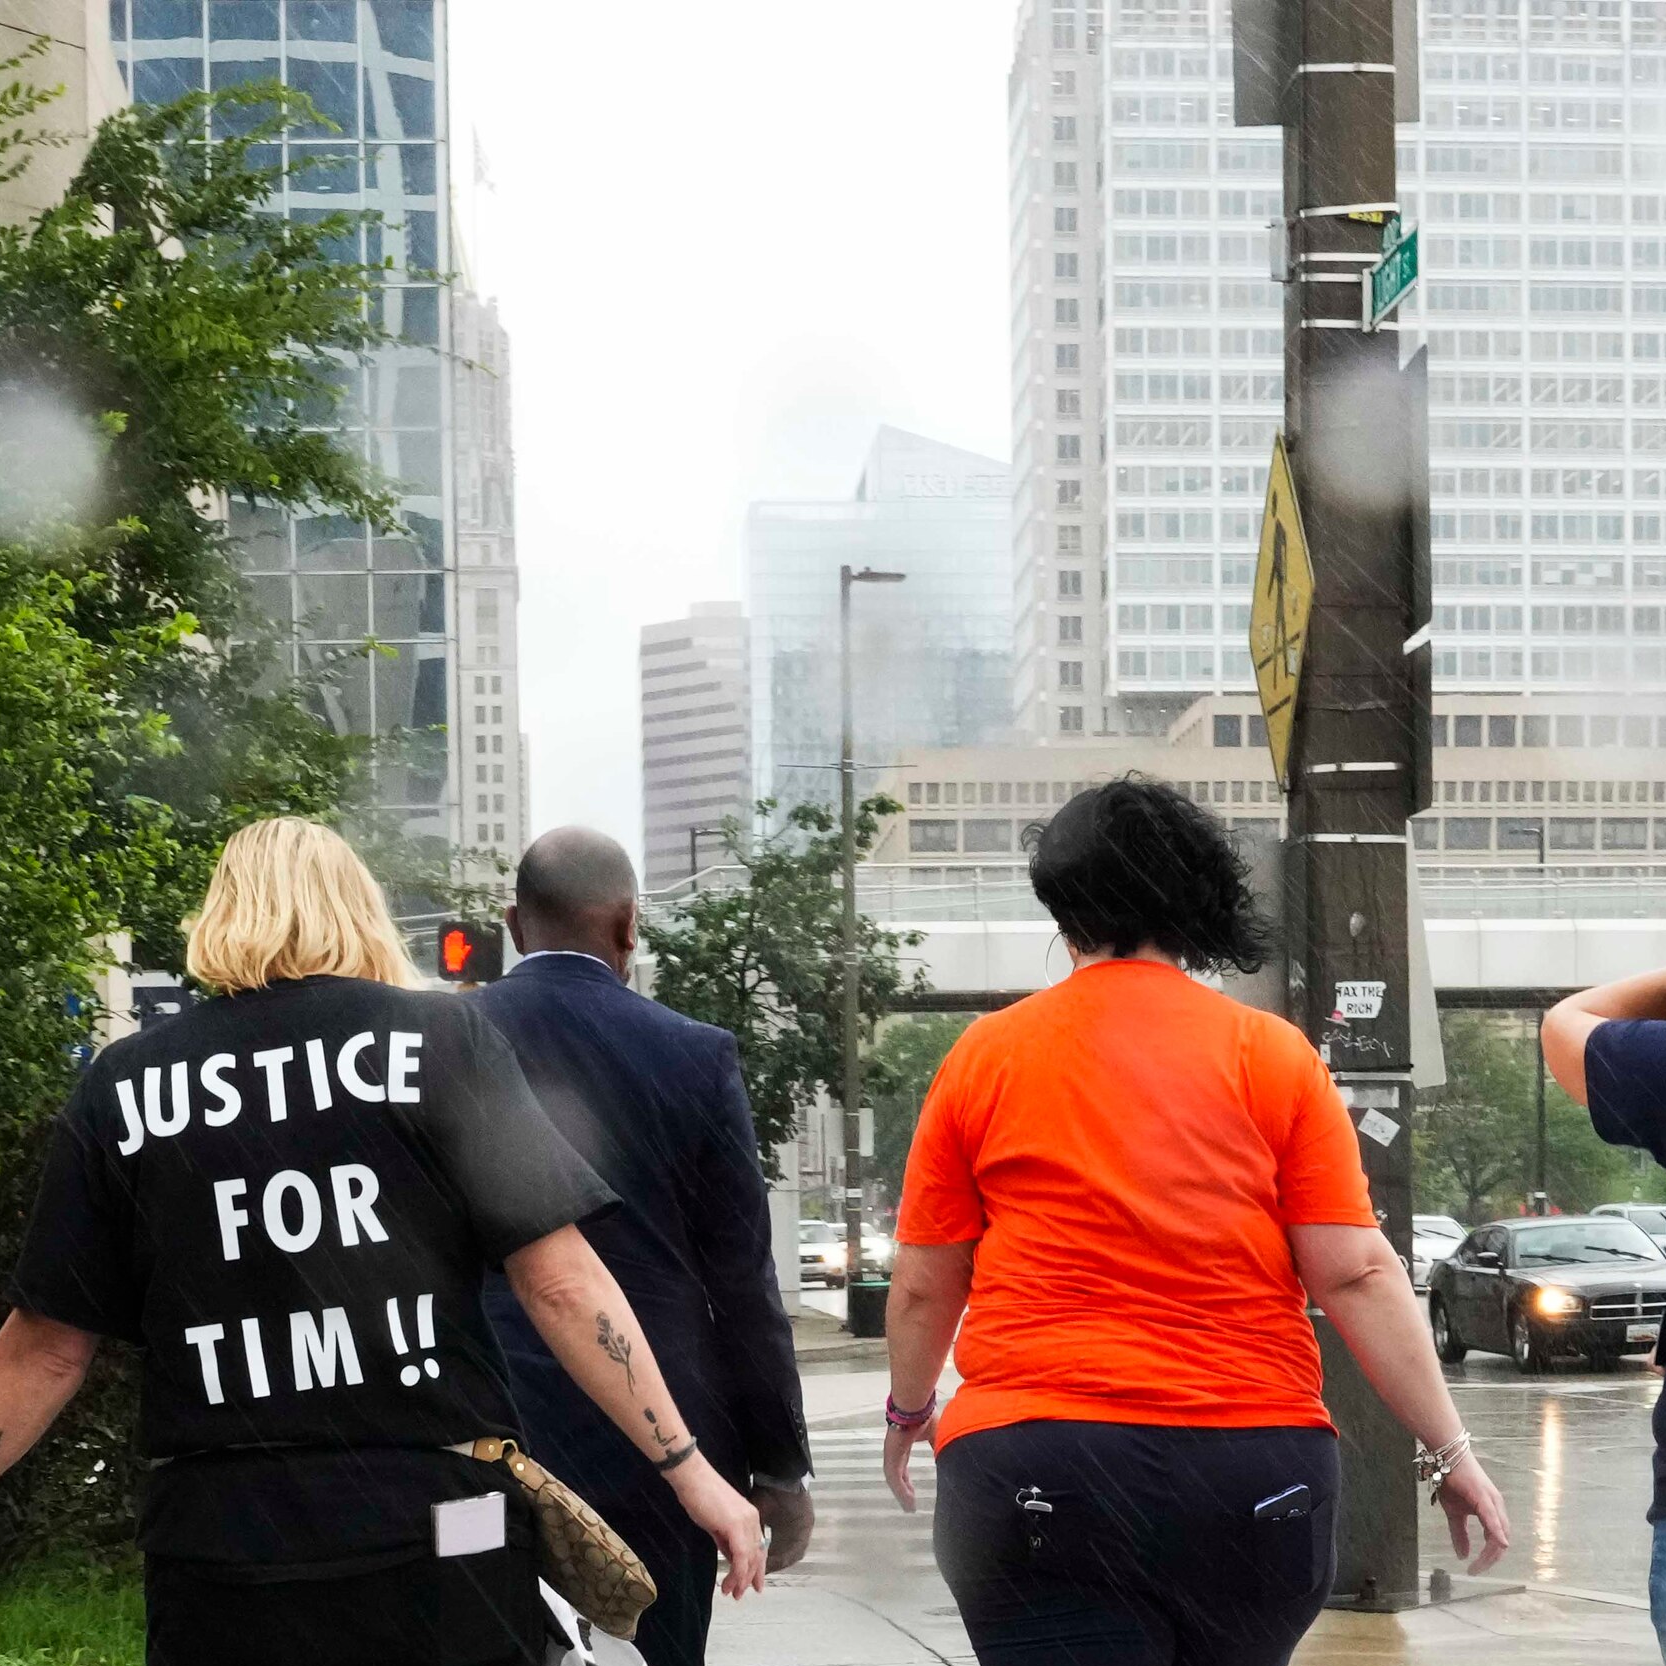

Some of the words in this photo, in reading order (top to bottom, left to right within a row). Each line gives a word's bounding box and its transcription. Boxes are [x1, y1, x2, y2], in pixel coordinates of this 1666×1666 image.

[1346, 1003, 1373, 1014] RICH
[116, 1032, 423, 1156] JUSTICE
[213, 1164, 390, 1261] FOR
